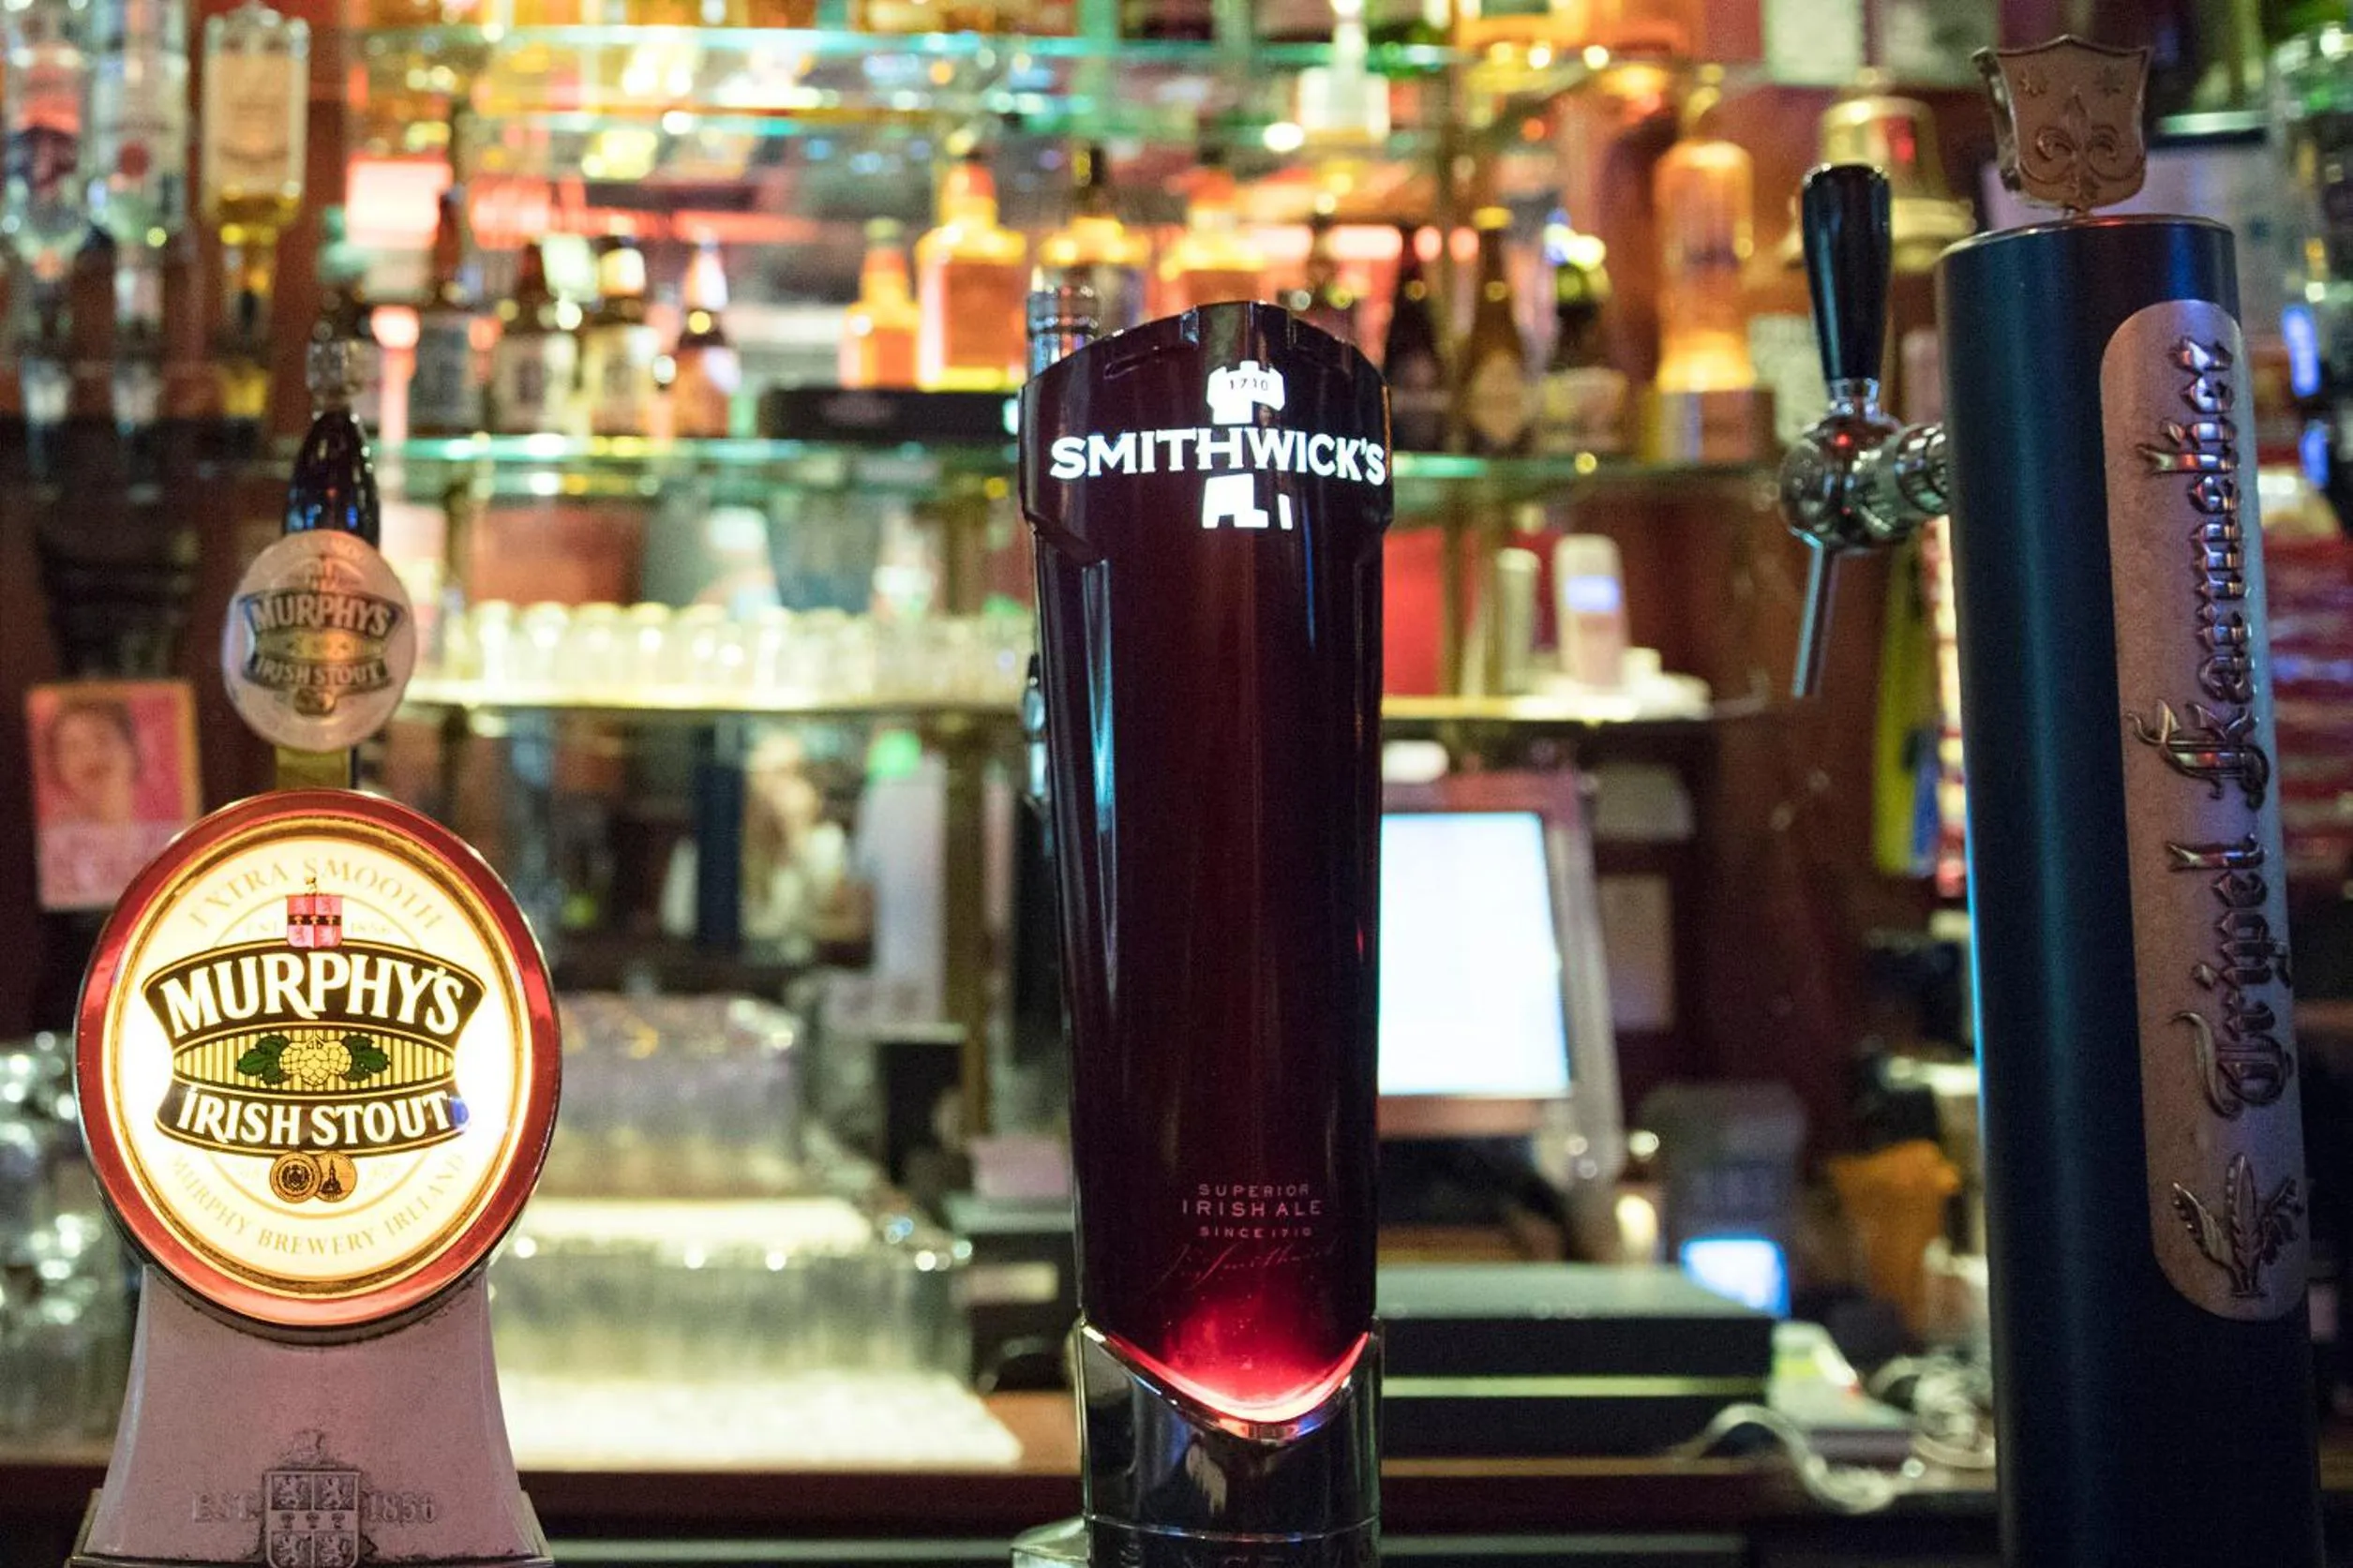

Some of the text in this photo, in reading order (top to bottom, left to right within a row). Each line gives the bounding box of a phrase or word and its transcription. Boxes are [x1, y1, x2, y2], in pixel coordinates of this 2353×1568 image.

[1228, 377, 1269, 392] 1710
[1049, 427, 1387, 486] SMITHWICK'S
[254, 656, 381, 685] IRISH STOUT
[188, 857, 444, 930] EXTRA SMOOTH
[159, 952, 464, 1039] MURPHY'S
[176, 1091, 452, 1146] IRISH STOUT
[171, 1153, 252, 1236] MURPHY
[257, 1227, 376, 1256] BREWERY
[383, 1152, 466, 1237] IRELAND
[1182, 1199, 1323, 1217] IRISH ALE
[1198, 1183, 1309, 1198] SUPERIOR
[1199, 1226, 1312, 1239] SINCE 1710
